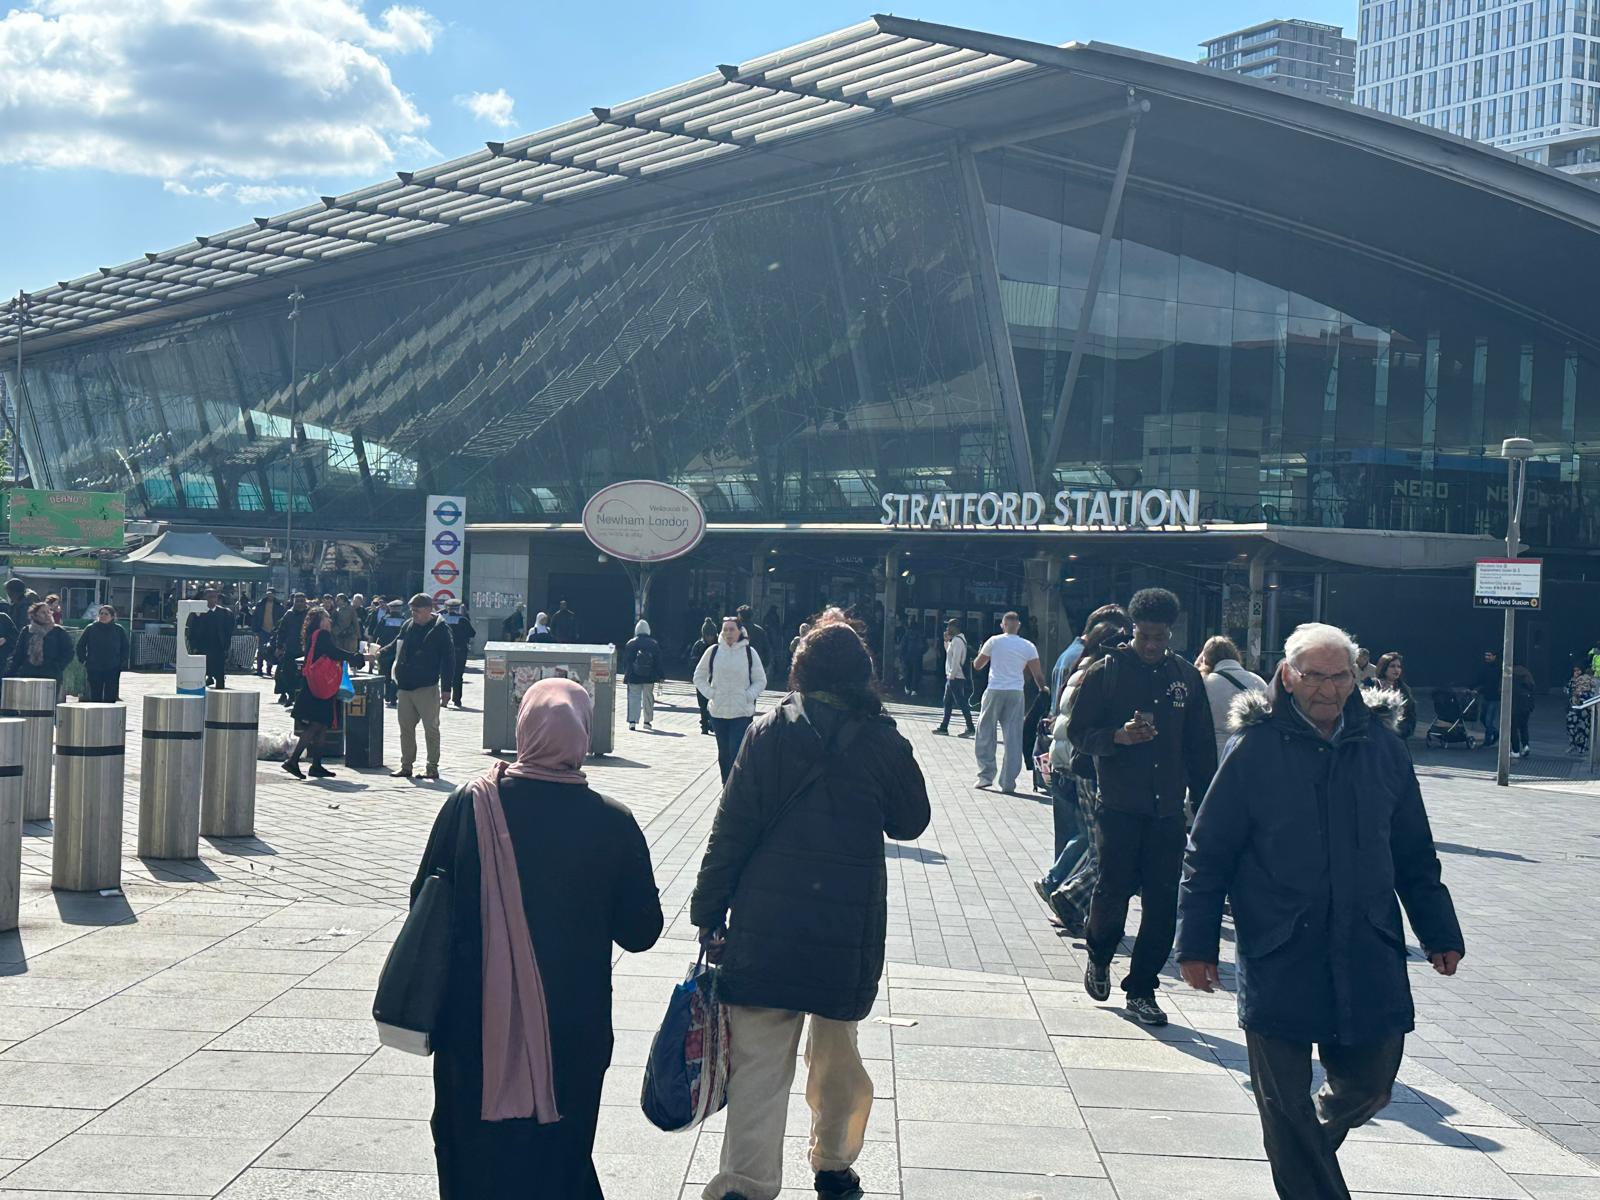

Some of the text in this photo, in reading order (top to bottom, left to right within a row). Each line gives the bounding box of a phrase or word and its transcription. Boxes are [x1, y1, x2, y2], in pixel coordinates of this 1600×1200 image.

[1394, 479, 1449, 499] NERO
[1487, 486, 1538, 504] NEO
[880, 489, 1199, 526] STRATFORD STATION
[596, 514, 689, 527] Newham London
[1489, 598, 1511, 606] Maryland
